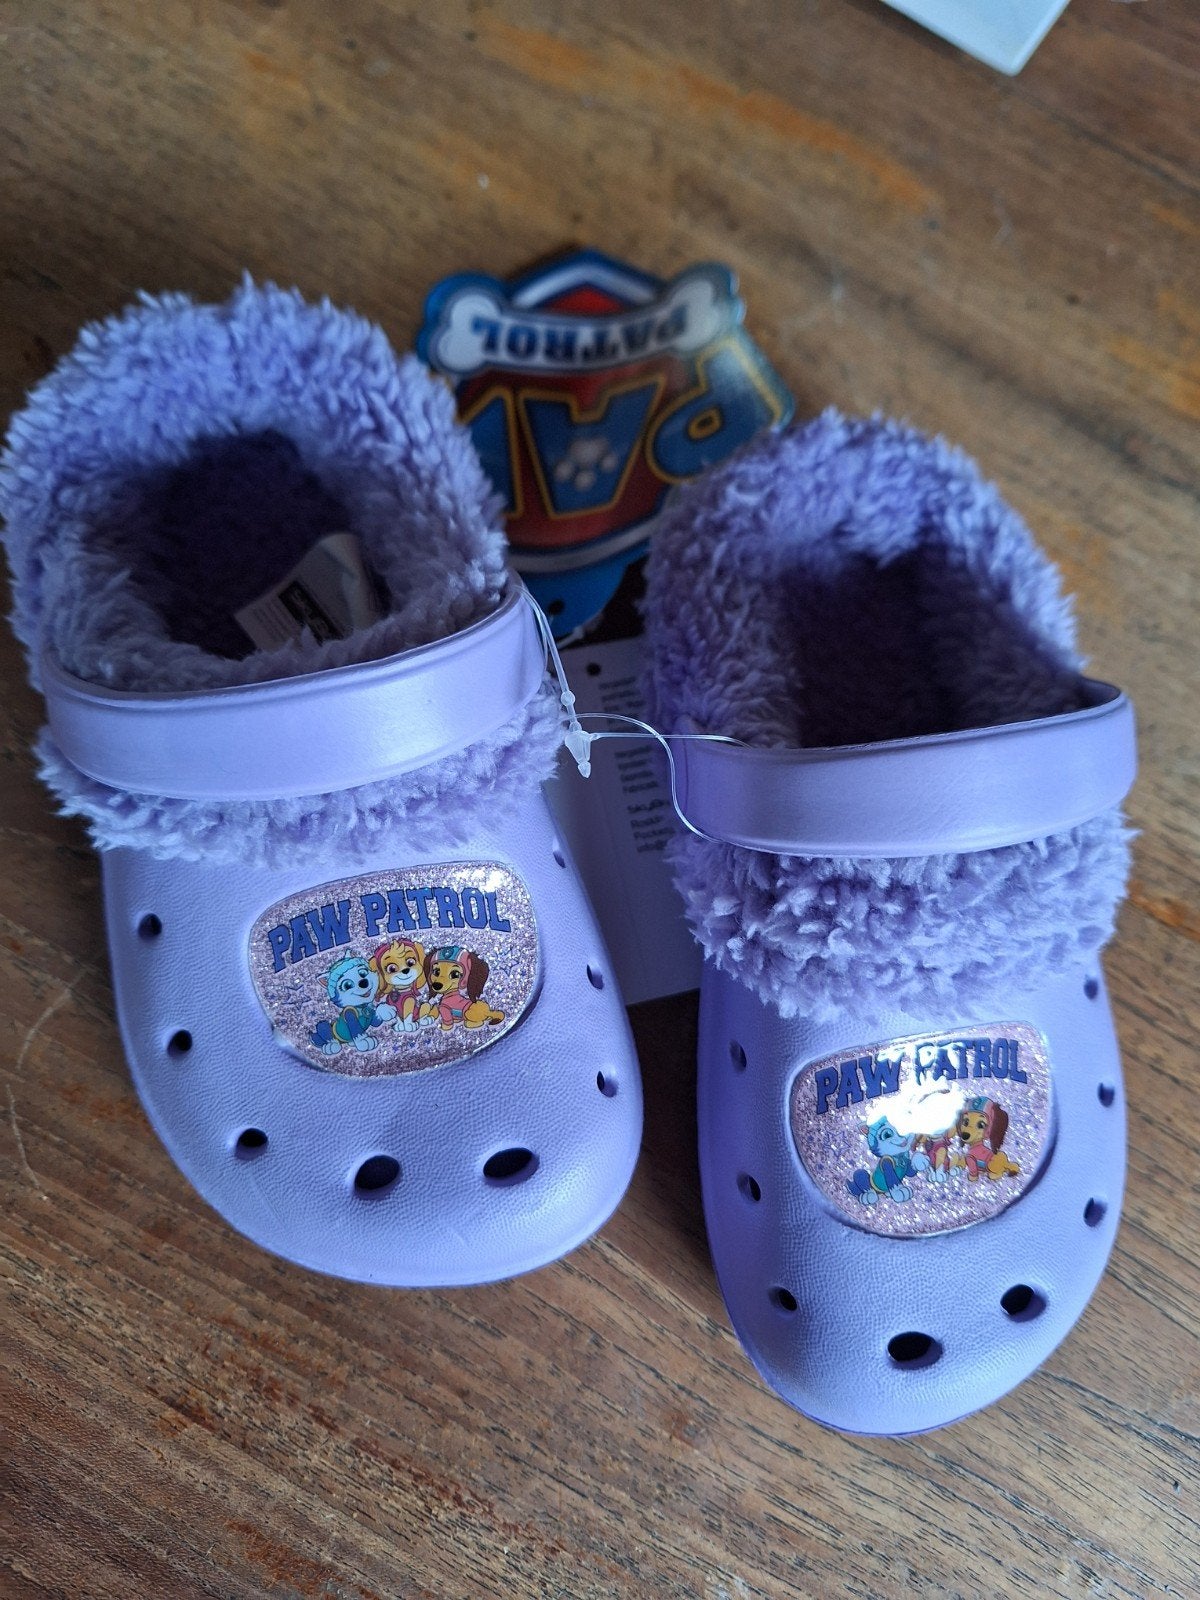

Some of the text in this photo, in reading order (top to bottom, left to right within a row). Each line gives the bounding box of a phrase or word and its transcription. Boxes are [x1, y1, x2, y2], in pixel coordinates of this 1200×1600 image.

[471, 305, 689, 363] PATROL
[267, 886, 512, 973] PAW PATROL
[814, 1054, 905, 1115] PAW
